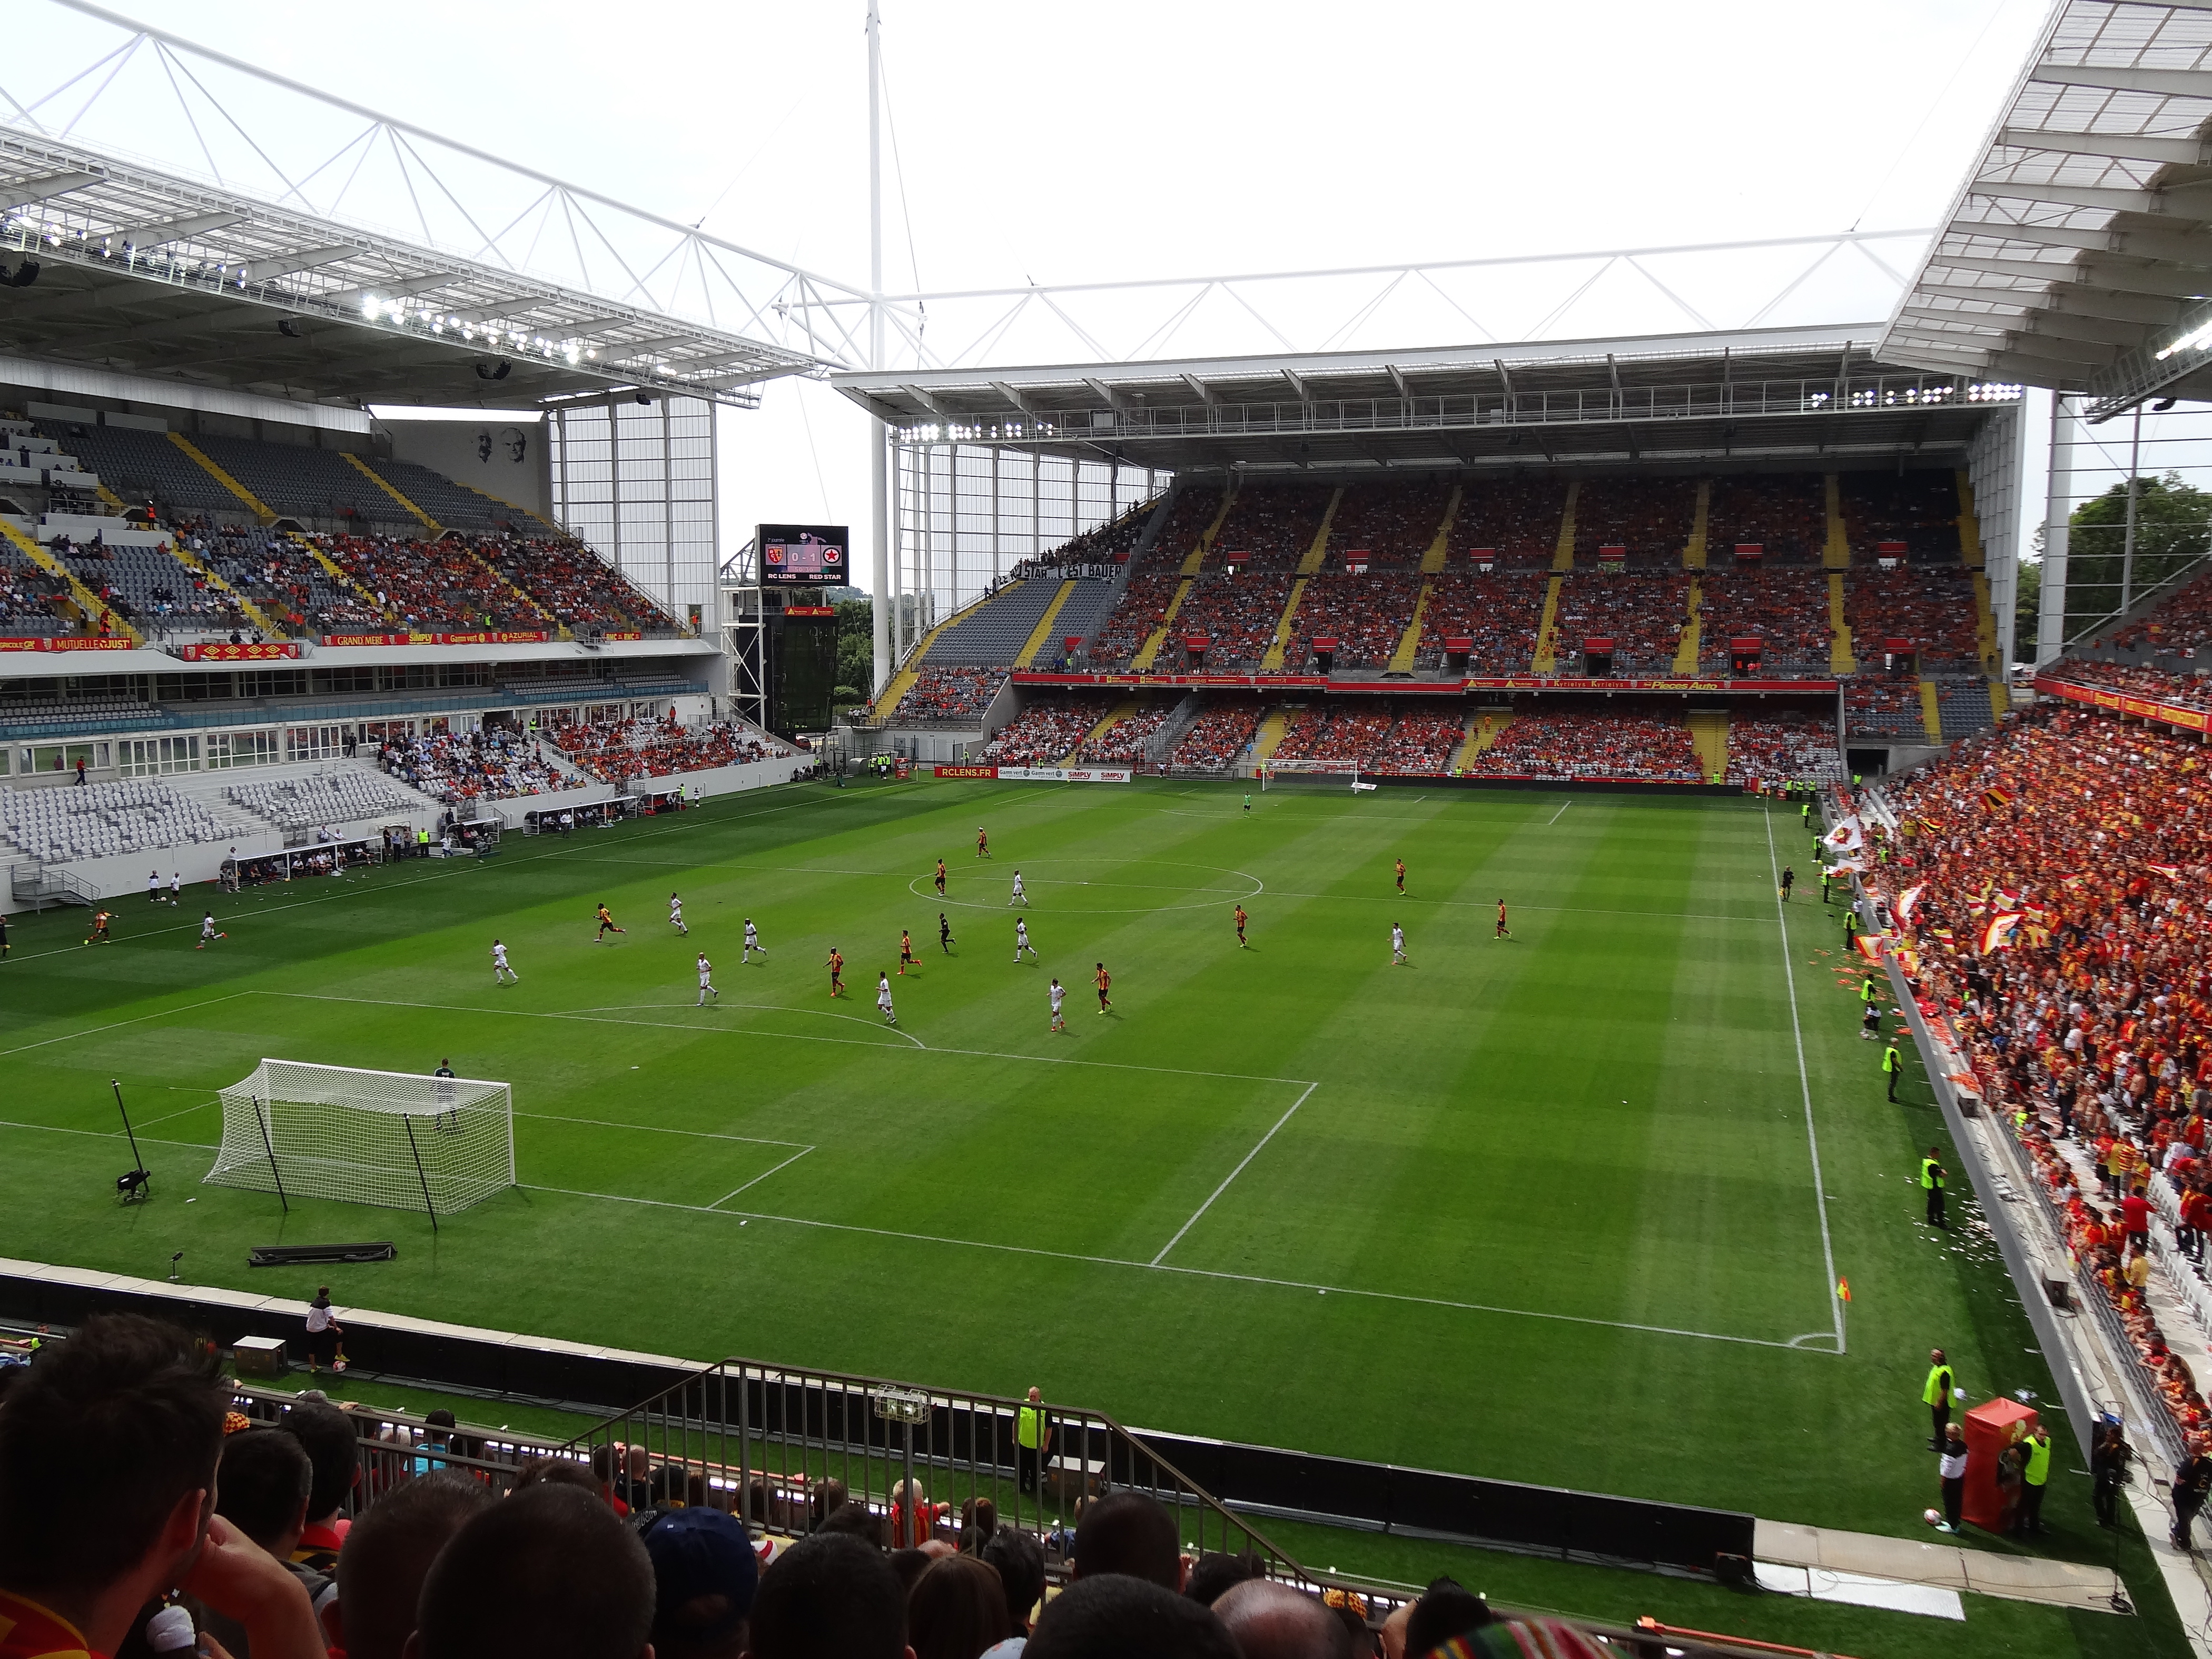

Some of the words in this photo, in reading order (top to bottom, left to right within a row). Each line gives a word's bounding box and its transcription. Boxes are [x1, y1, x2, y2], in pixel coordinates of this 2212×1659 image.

[792, 552, 799, 561] 0
[810, 553, 816, 561] 1
[1089, 565, 1121, 578] BAUER
[450, 634, 466, 643] Gamm
[56, 639, 99, 649] MUTUELLE
[942, 768, 991, 777] RCLENS.FR
